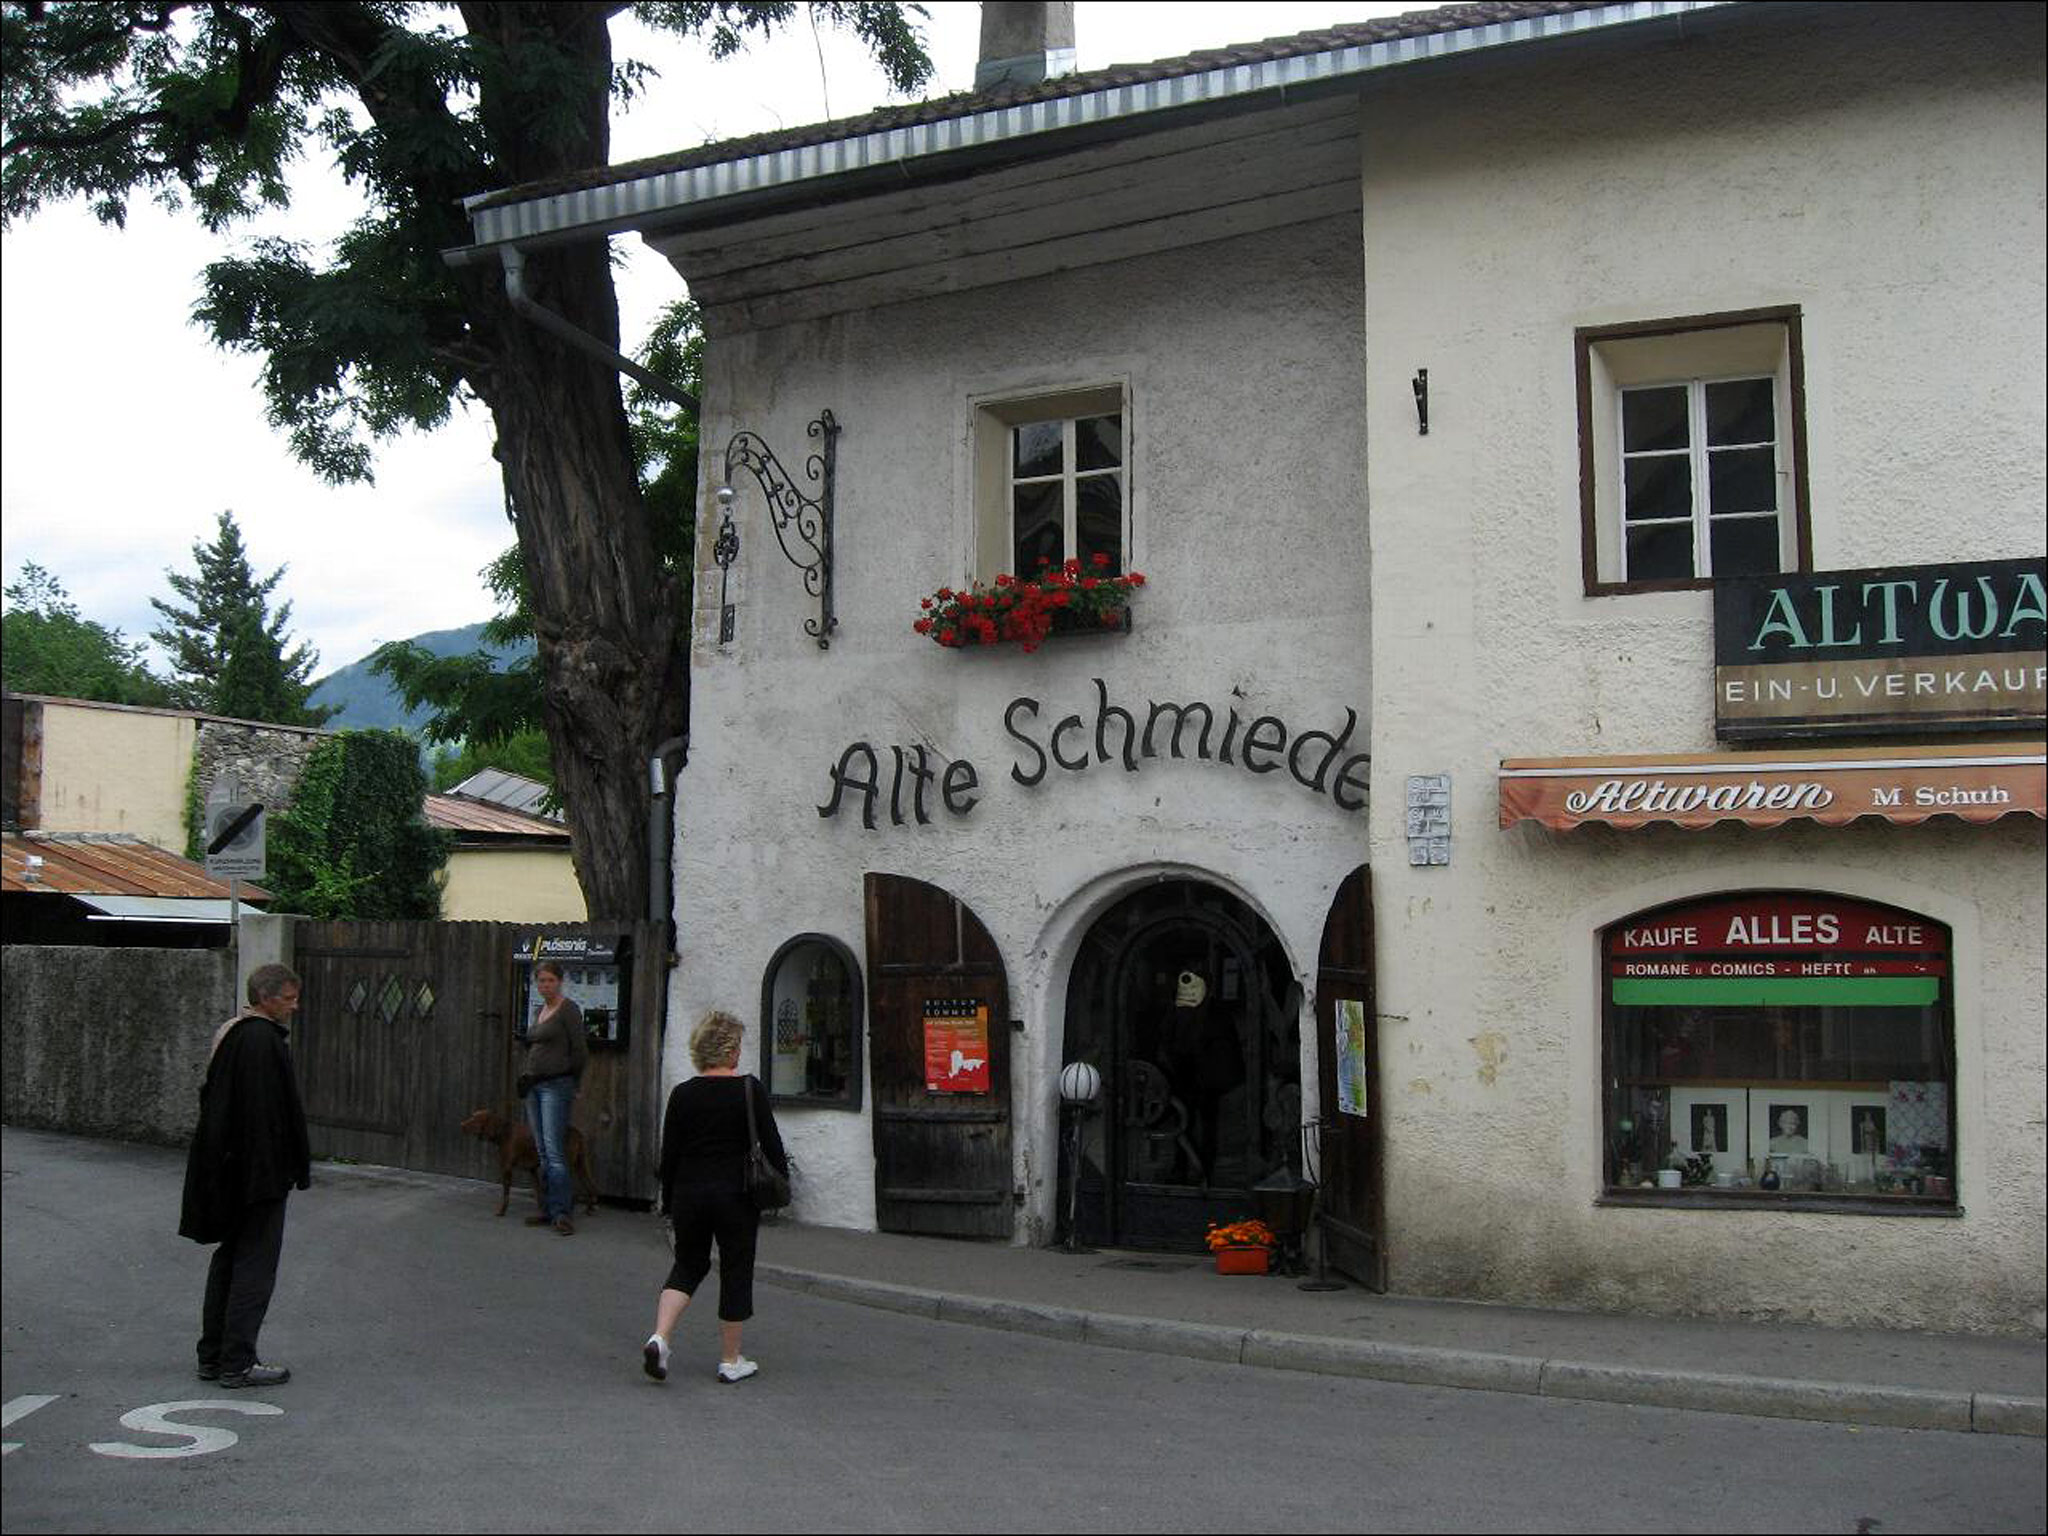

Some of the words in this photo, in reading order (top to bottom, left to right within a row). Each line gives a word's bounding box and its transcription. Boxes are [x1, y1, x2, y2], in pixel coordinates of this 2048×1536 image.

[817, 741, 981, 830] Alte
[1003, 677, 1371, 812] Schmiede
[1565, 779, 1835, 814] Altwaren
[1915, 785, 2011, 806] Schuh
[1624, 926, 1698, 948] KAUFE
[1725, 913, 1841, 945] ALLES
[1865, 925, 1923, 945] ALTE
[1625, 963, 1691, 976] ROMANE
[1710, 962, 1776, 976] COMICS
